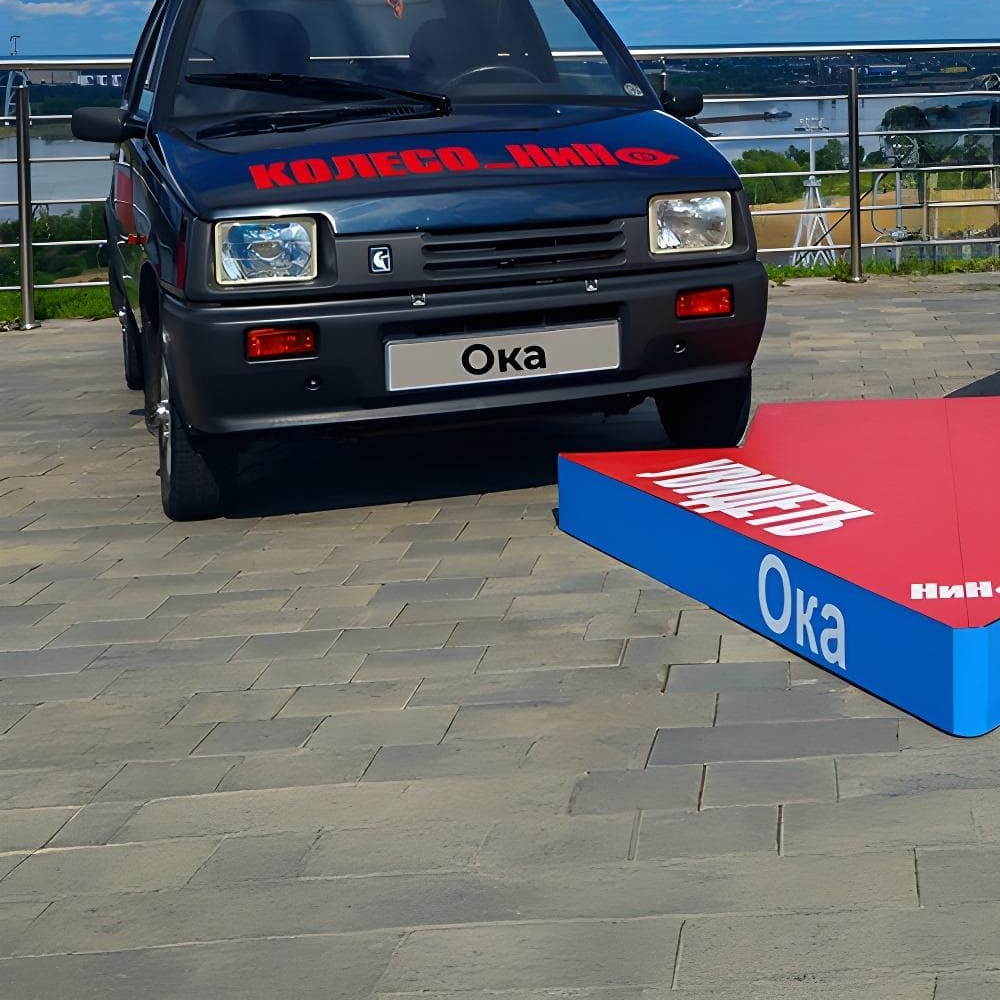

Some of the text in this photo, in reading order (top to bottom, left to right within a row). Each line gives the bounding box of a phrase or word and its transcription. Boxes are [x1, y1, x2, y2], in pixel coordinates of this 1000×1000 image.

[461, 343, 547, 375] Ока
[636, 458, 875, 537] УВИДЕТЬ
[758, 553, 847, 670] Ока
